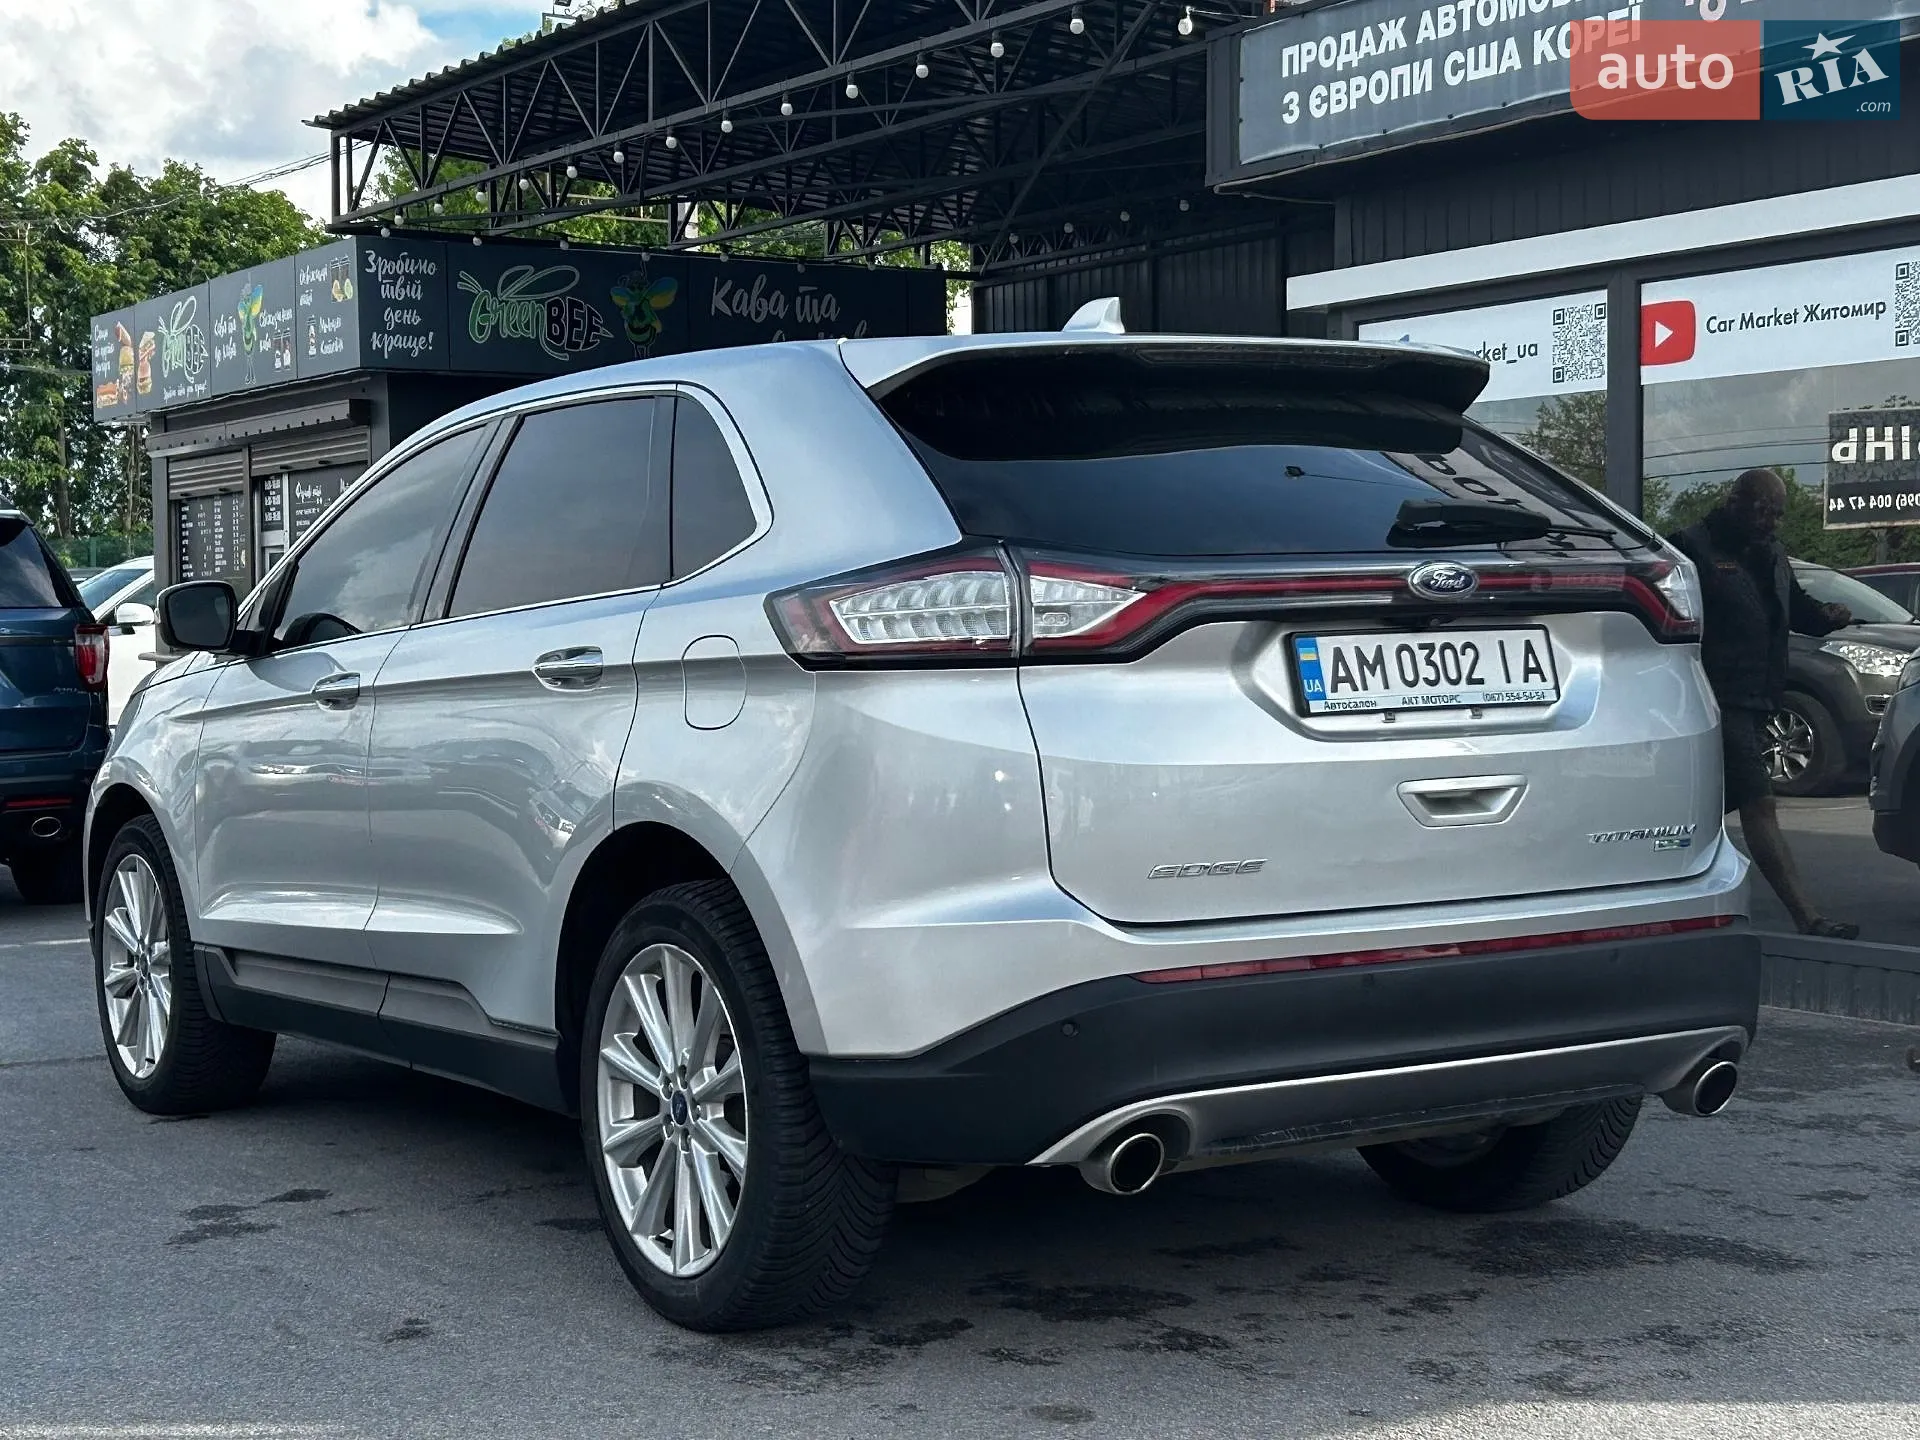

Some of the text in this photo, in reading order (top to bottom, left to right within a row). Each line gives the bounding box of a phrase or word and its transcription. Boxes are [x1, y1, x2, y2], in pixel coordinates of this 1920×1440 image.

[1282, 16, 1408, 78] ПРОДАЖ
[1282, 0, 1643, 124] З ЄВРОПИ США КОРЕЇ
[364, 249, 438, 282] Зробимо
[380, 278, 424, 301] твій
[710, 273, 841, 324] Кава та
[383, 305, 422, 331] день
[1706, 300, 1887, 334] Car Market Житомир
[370, 331, 434, 359] краще!
[1430, 569, 1465, 589] Ford
[1329, 638, 1549, 694] AM 0302 IA
[1303, 679, 1323, 694] UA
[1323, 699, 1378, 711] Автосалон
[1421, 693, 1462, 705] МОТОРС
[1585, 823, 1698, 844] TITANIUM
[1146, 858, 1269, 880] EDGE
